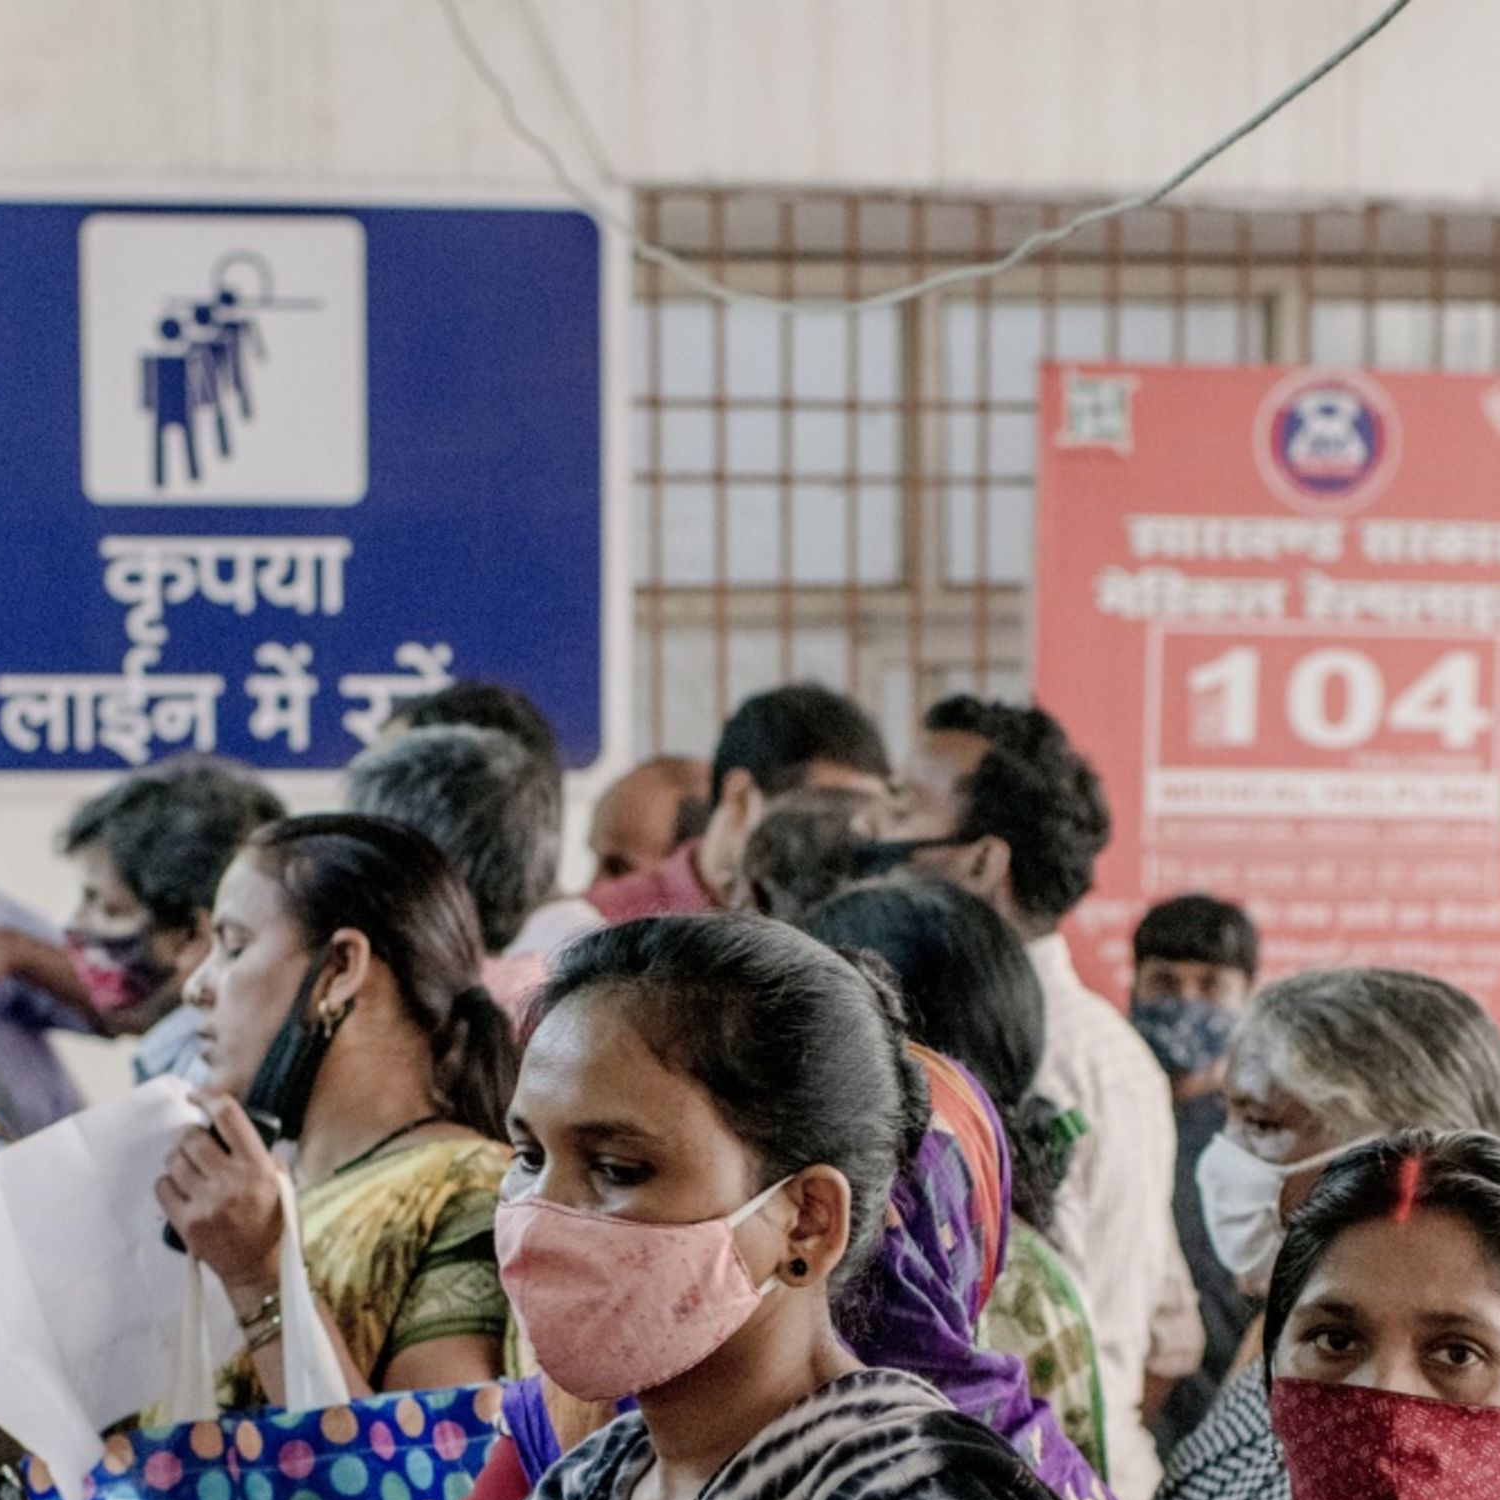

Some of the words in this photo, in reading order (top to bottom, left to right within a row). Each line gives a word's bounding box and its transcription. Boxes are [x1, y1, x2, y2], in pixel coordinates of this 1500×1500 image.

[99, 535, 353, 646] कृपया
[244, 643, 319, 752] में
[337, 642, 455, 748] रें
[1187, 645, 1494, 752] 104
